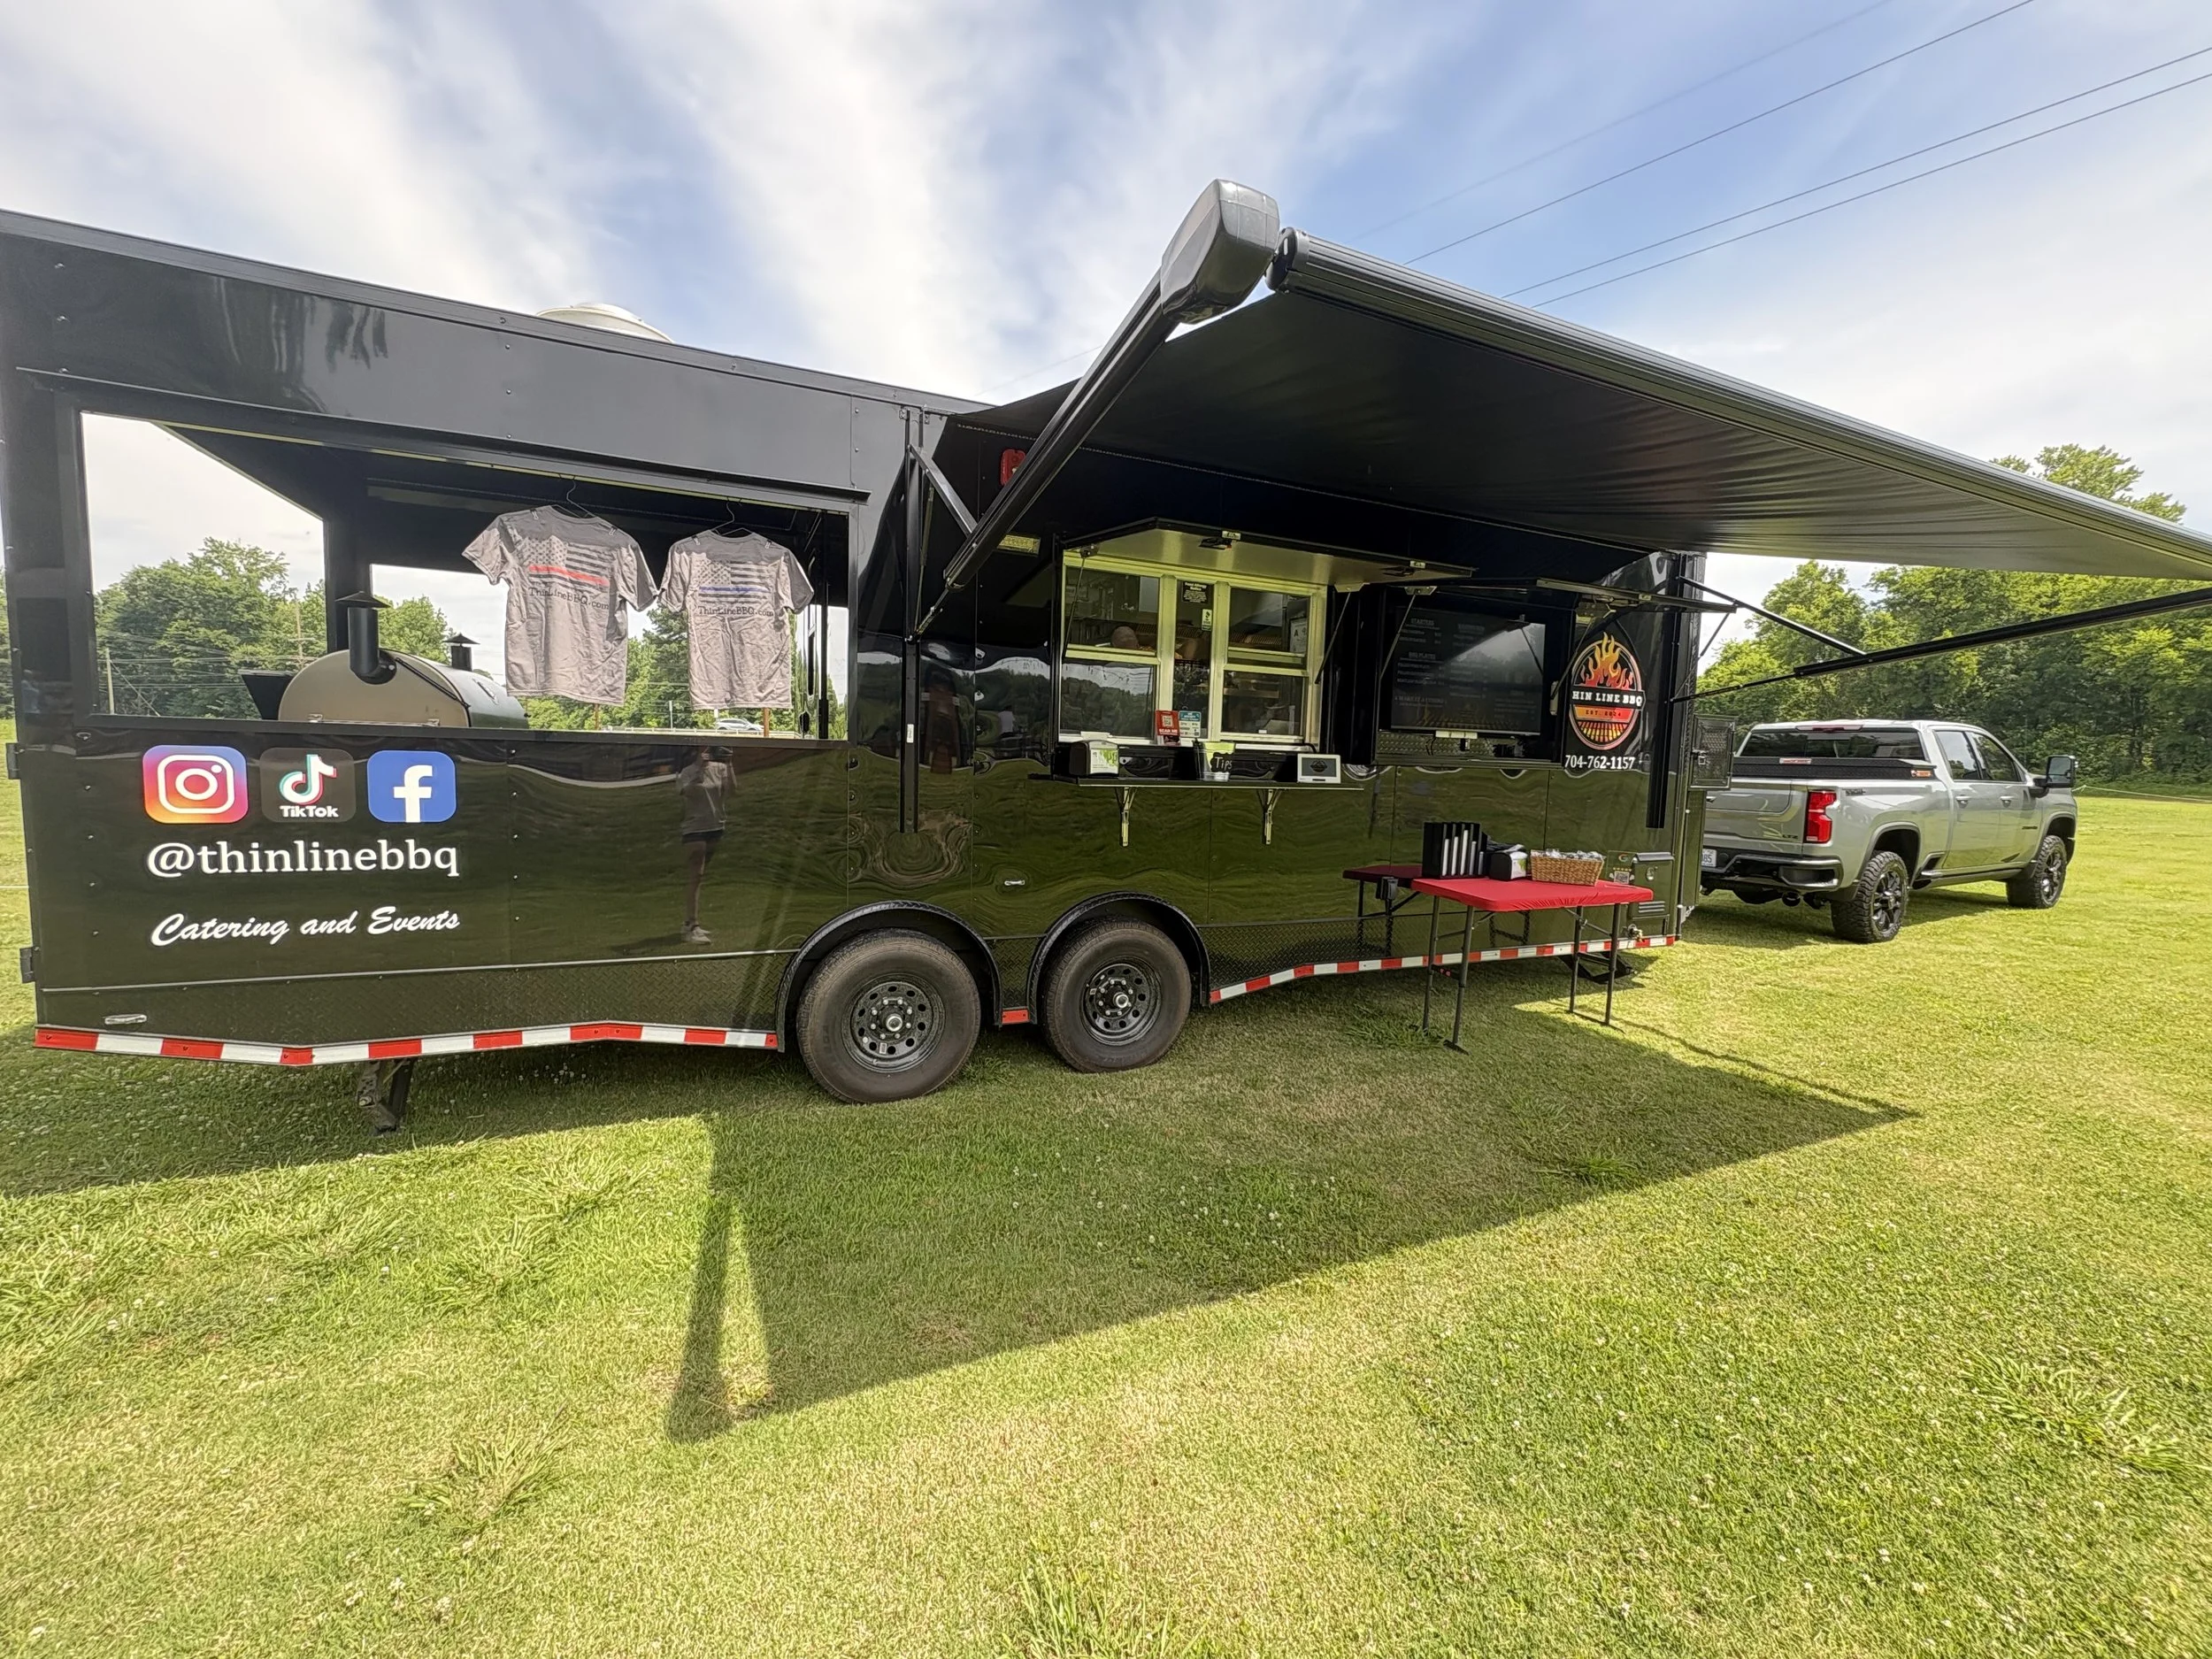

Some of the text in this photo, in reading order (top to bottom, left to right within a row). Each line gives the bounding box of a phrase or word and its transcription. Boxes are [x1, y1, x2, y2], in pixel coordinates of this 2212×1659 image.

[528, 587, 609, 610] ThinLineBBQ.com
[697, 605, 774, 617] ThinLineBBQ.com
[1571, 690, 1643, 707] HIN LINE BBQ
[1214, 757, 1233, 771] Tips
[1563, 755, 1637, 770] 704-762-1157
[280, 804, 340, 818] TikTok
[147, 839, 460, 878] @thinlinebbq
[150, 906, 460, 946] Catering and Events
